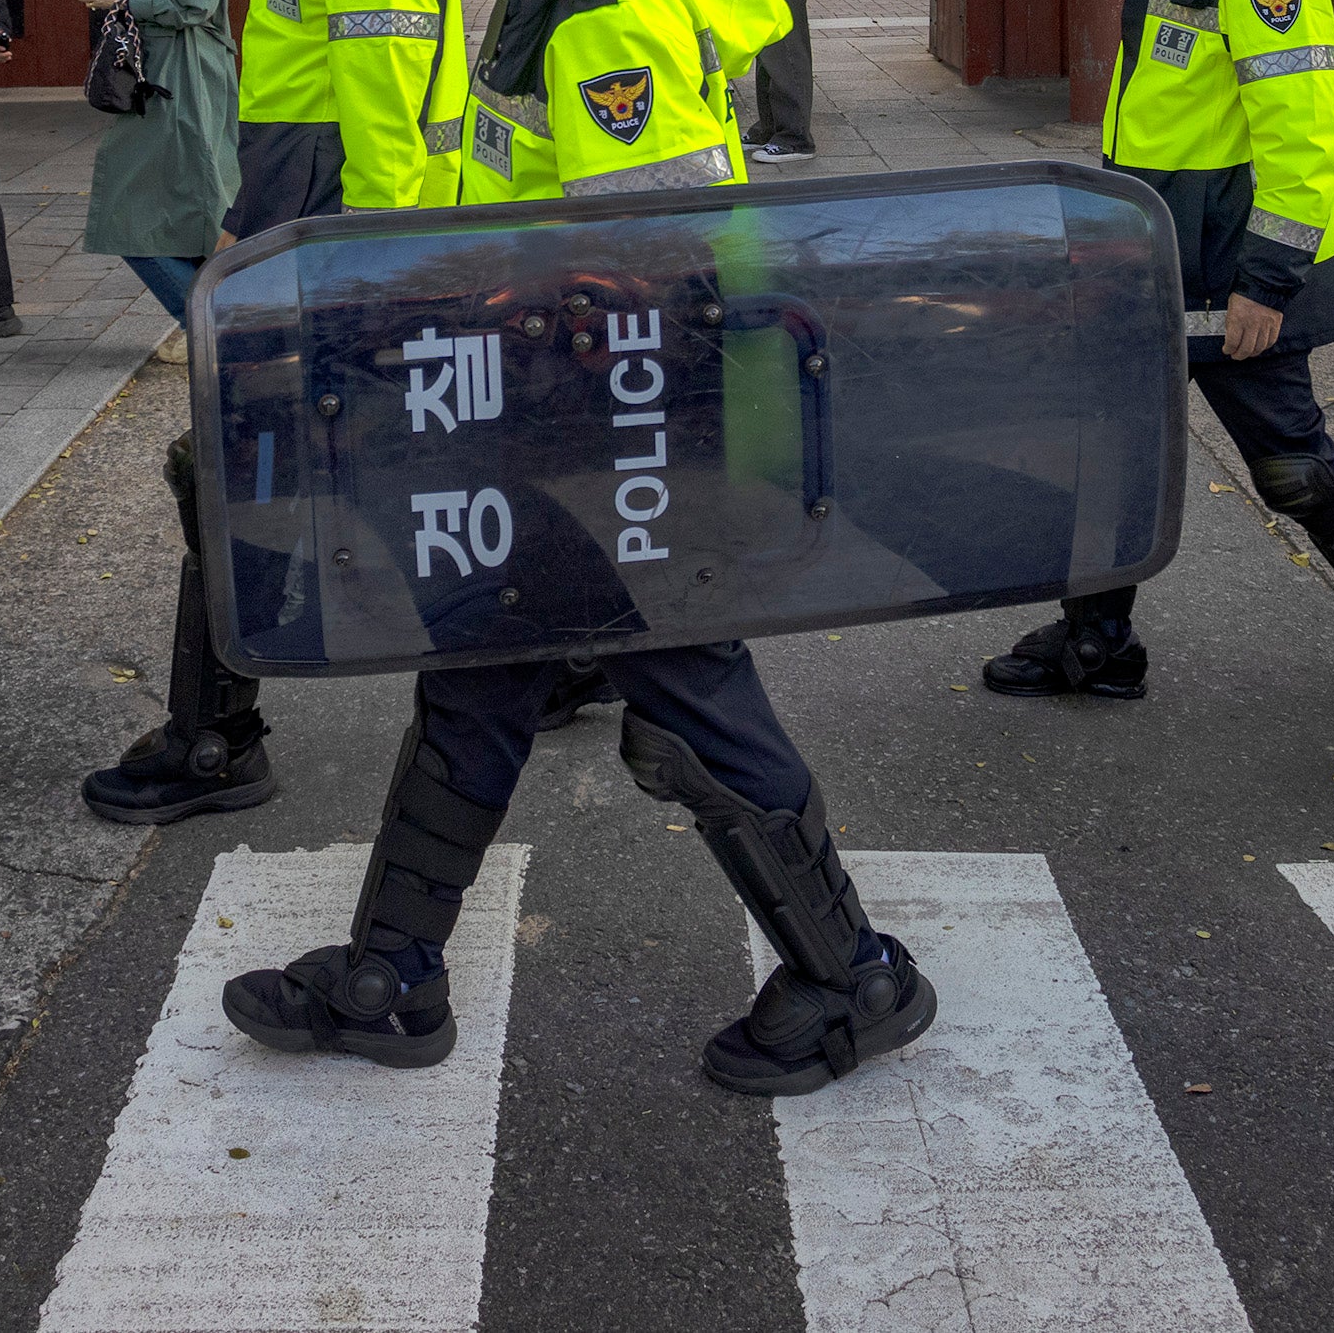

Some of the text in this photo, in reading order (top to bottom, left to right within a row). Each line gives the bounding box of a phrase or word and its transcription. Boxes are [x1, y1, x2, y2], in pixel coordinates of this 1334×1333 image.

[1160, 27, 1192, 51] 경찰
[1155, 47, 1186, 64] POLICE
[477, 114, 508, 154] 경찰
[611, 117, 640, 131] POLICE
[475, 144, 509, 172] POLICE
[607, 308, 669, 564] POLICE
